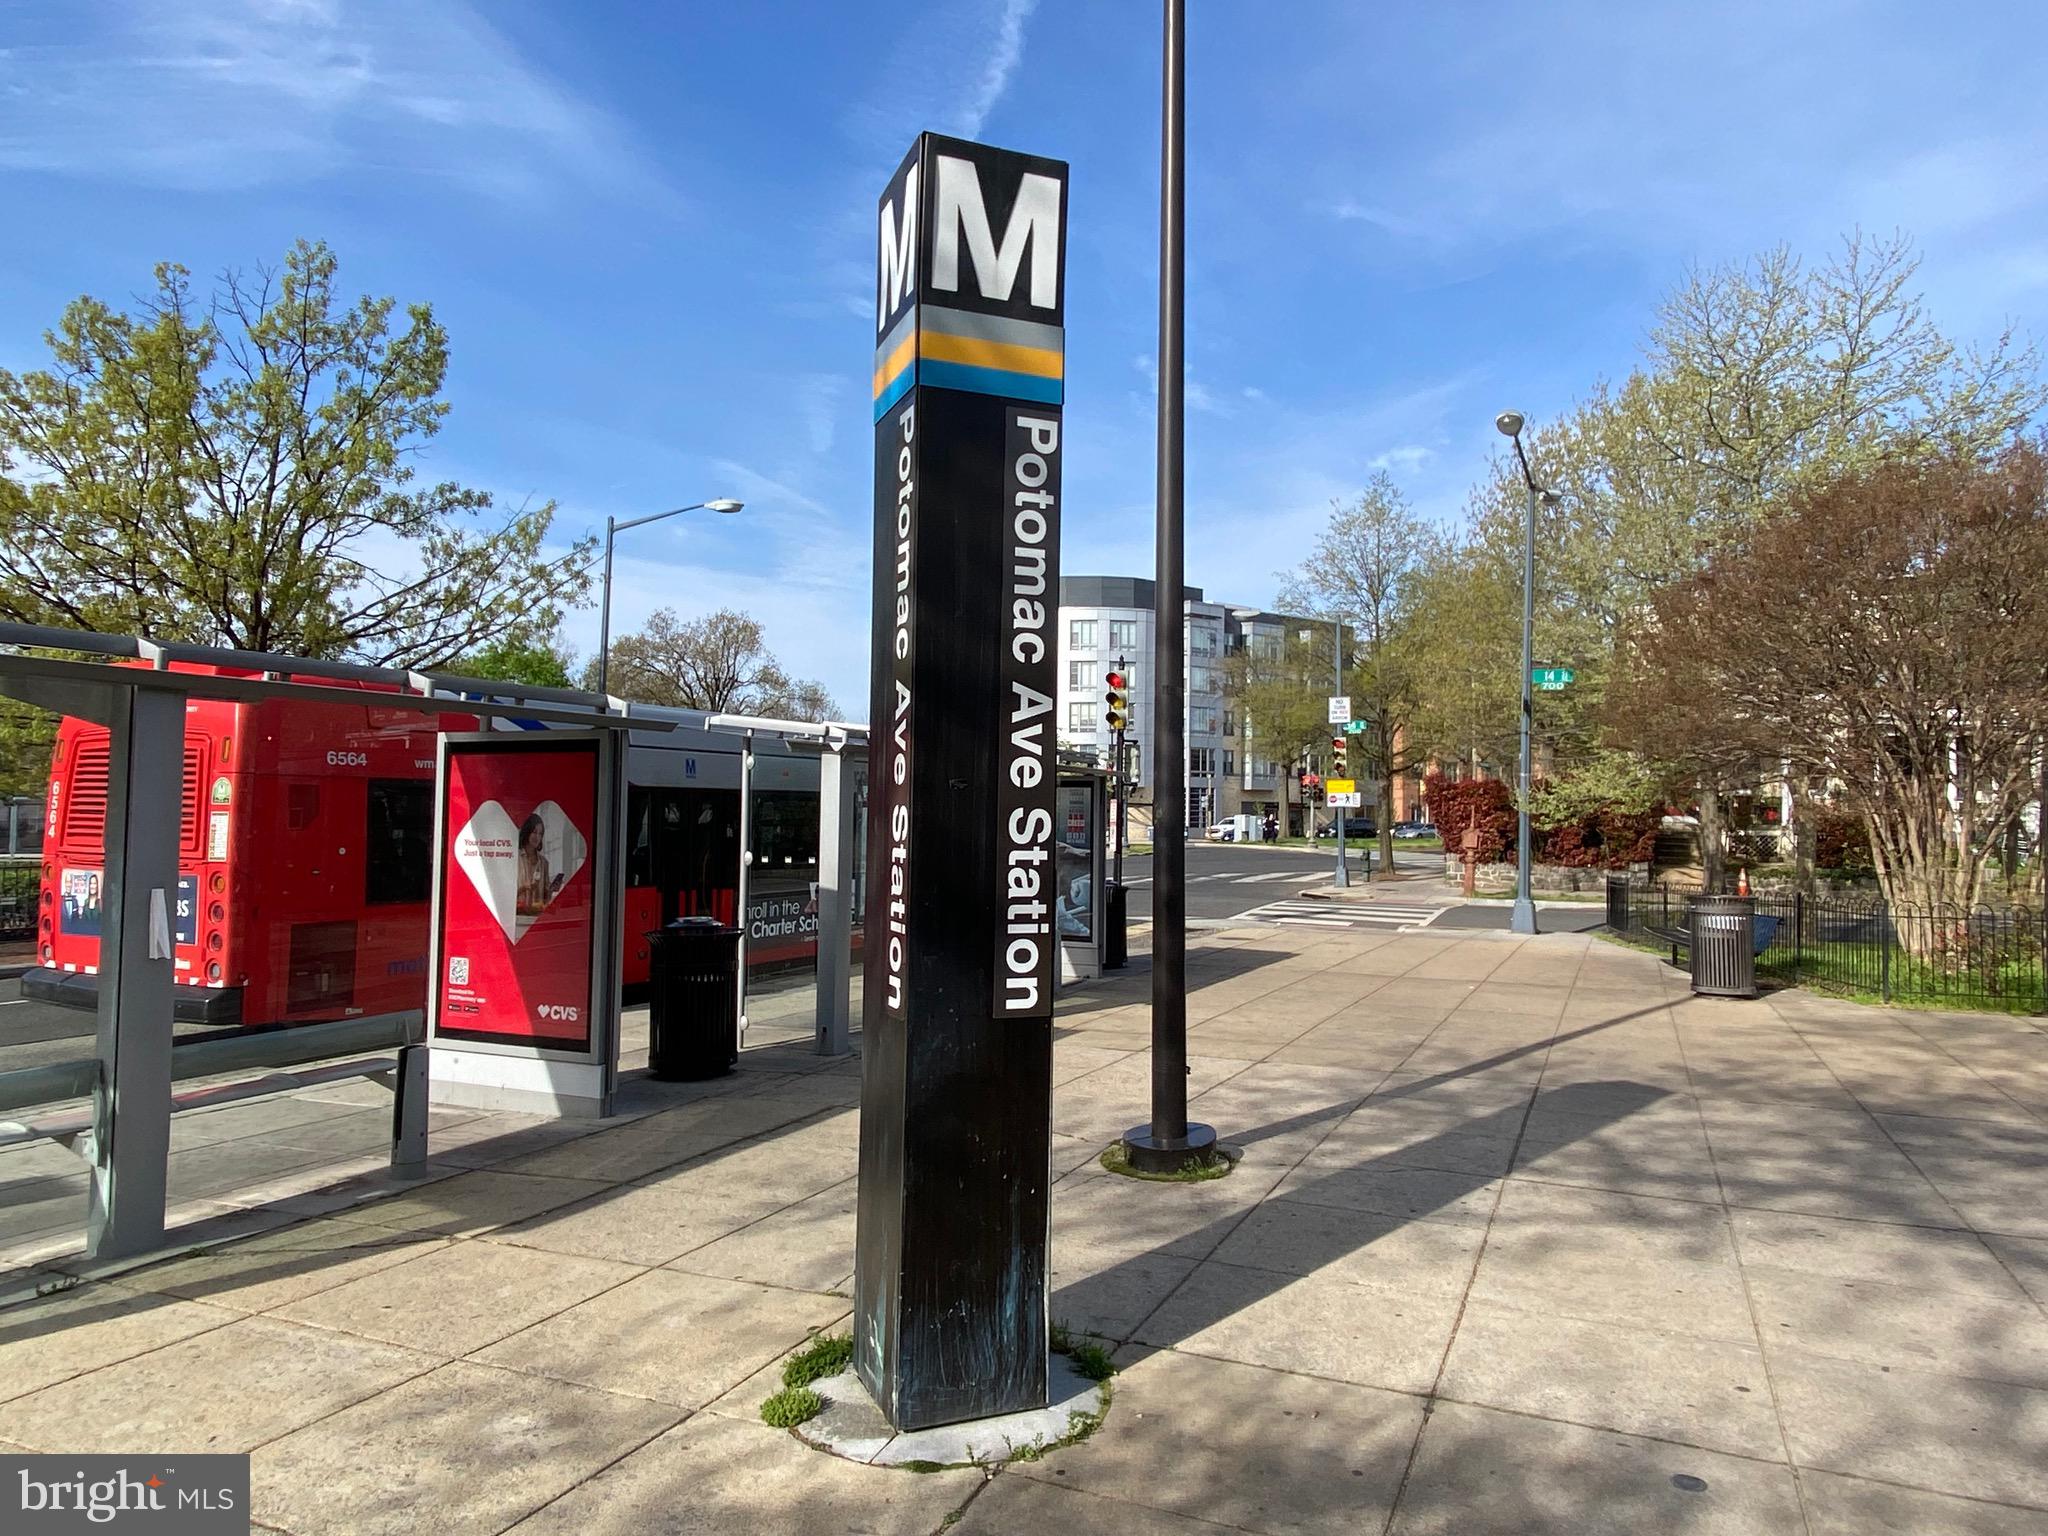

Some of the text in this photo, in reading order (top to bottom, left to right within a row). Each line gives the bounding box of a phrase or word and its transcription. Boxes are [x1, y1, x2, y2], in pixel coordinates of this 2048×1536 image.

[931, 154, 1062, 310] M
[878, 161, 918, 334] M
[1544, 670, 1555, 681] 14
[887, 403, 915, 1011] Potomac Ave Station
[1005, 415, 1059, 1011] Potomac Ave Station
[326, 751, 368, 766] 6564
[414, 758, 437, 769] wm
[685, 758, 697, 776] M
[48, 781, 60, 838] 6564
[464, 839, 479, 847] Your
[479, 839, 495, 847] local
[484, 850, 495, 858] tap
[746, 899, 800, 920] nroll in the
[751, 914, 819, 939] Charter Sch
[550, 1005, 578, 1022] CVS
